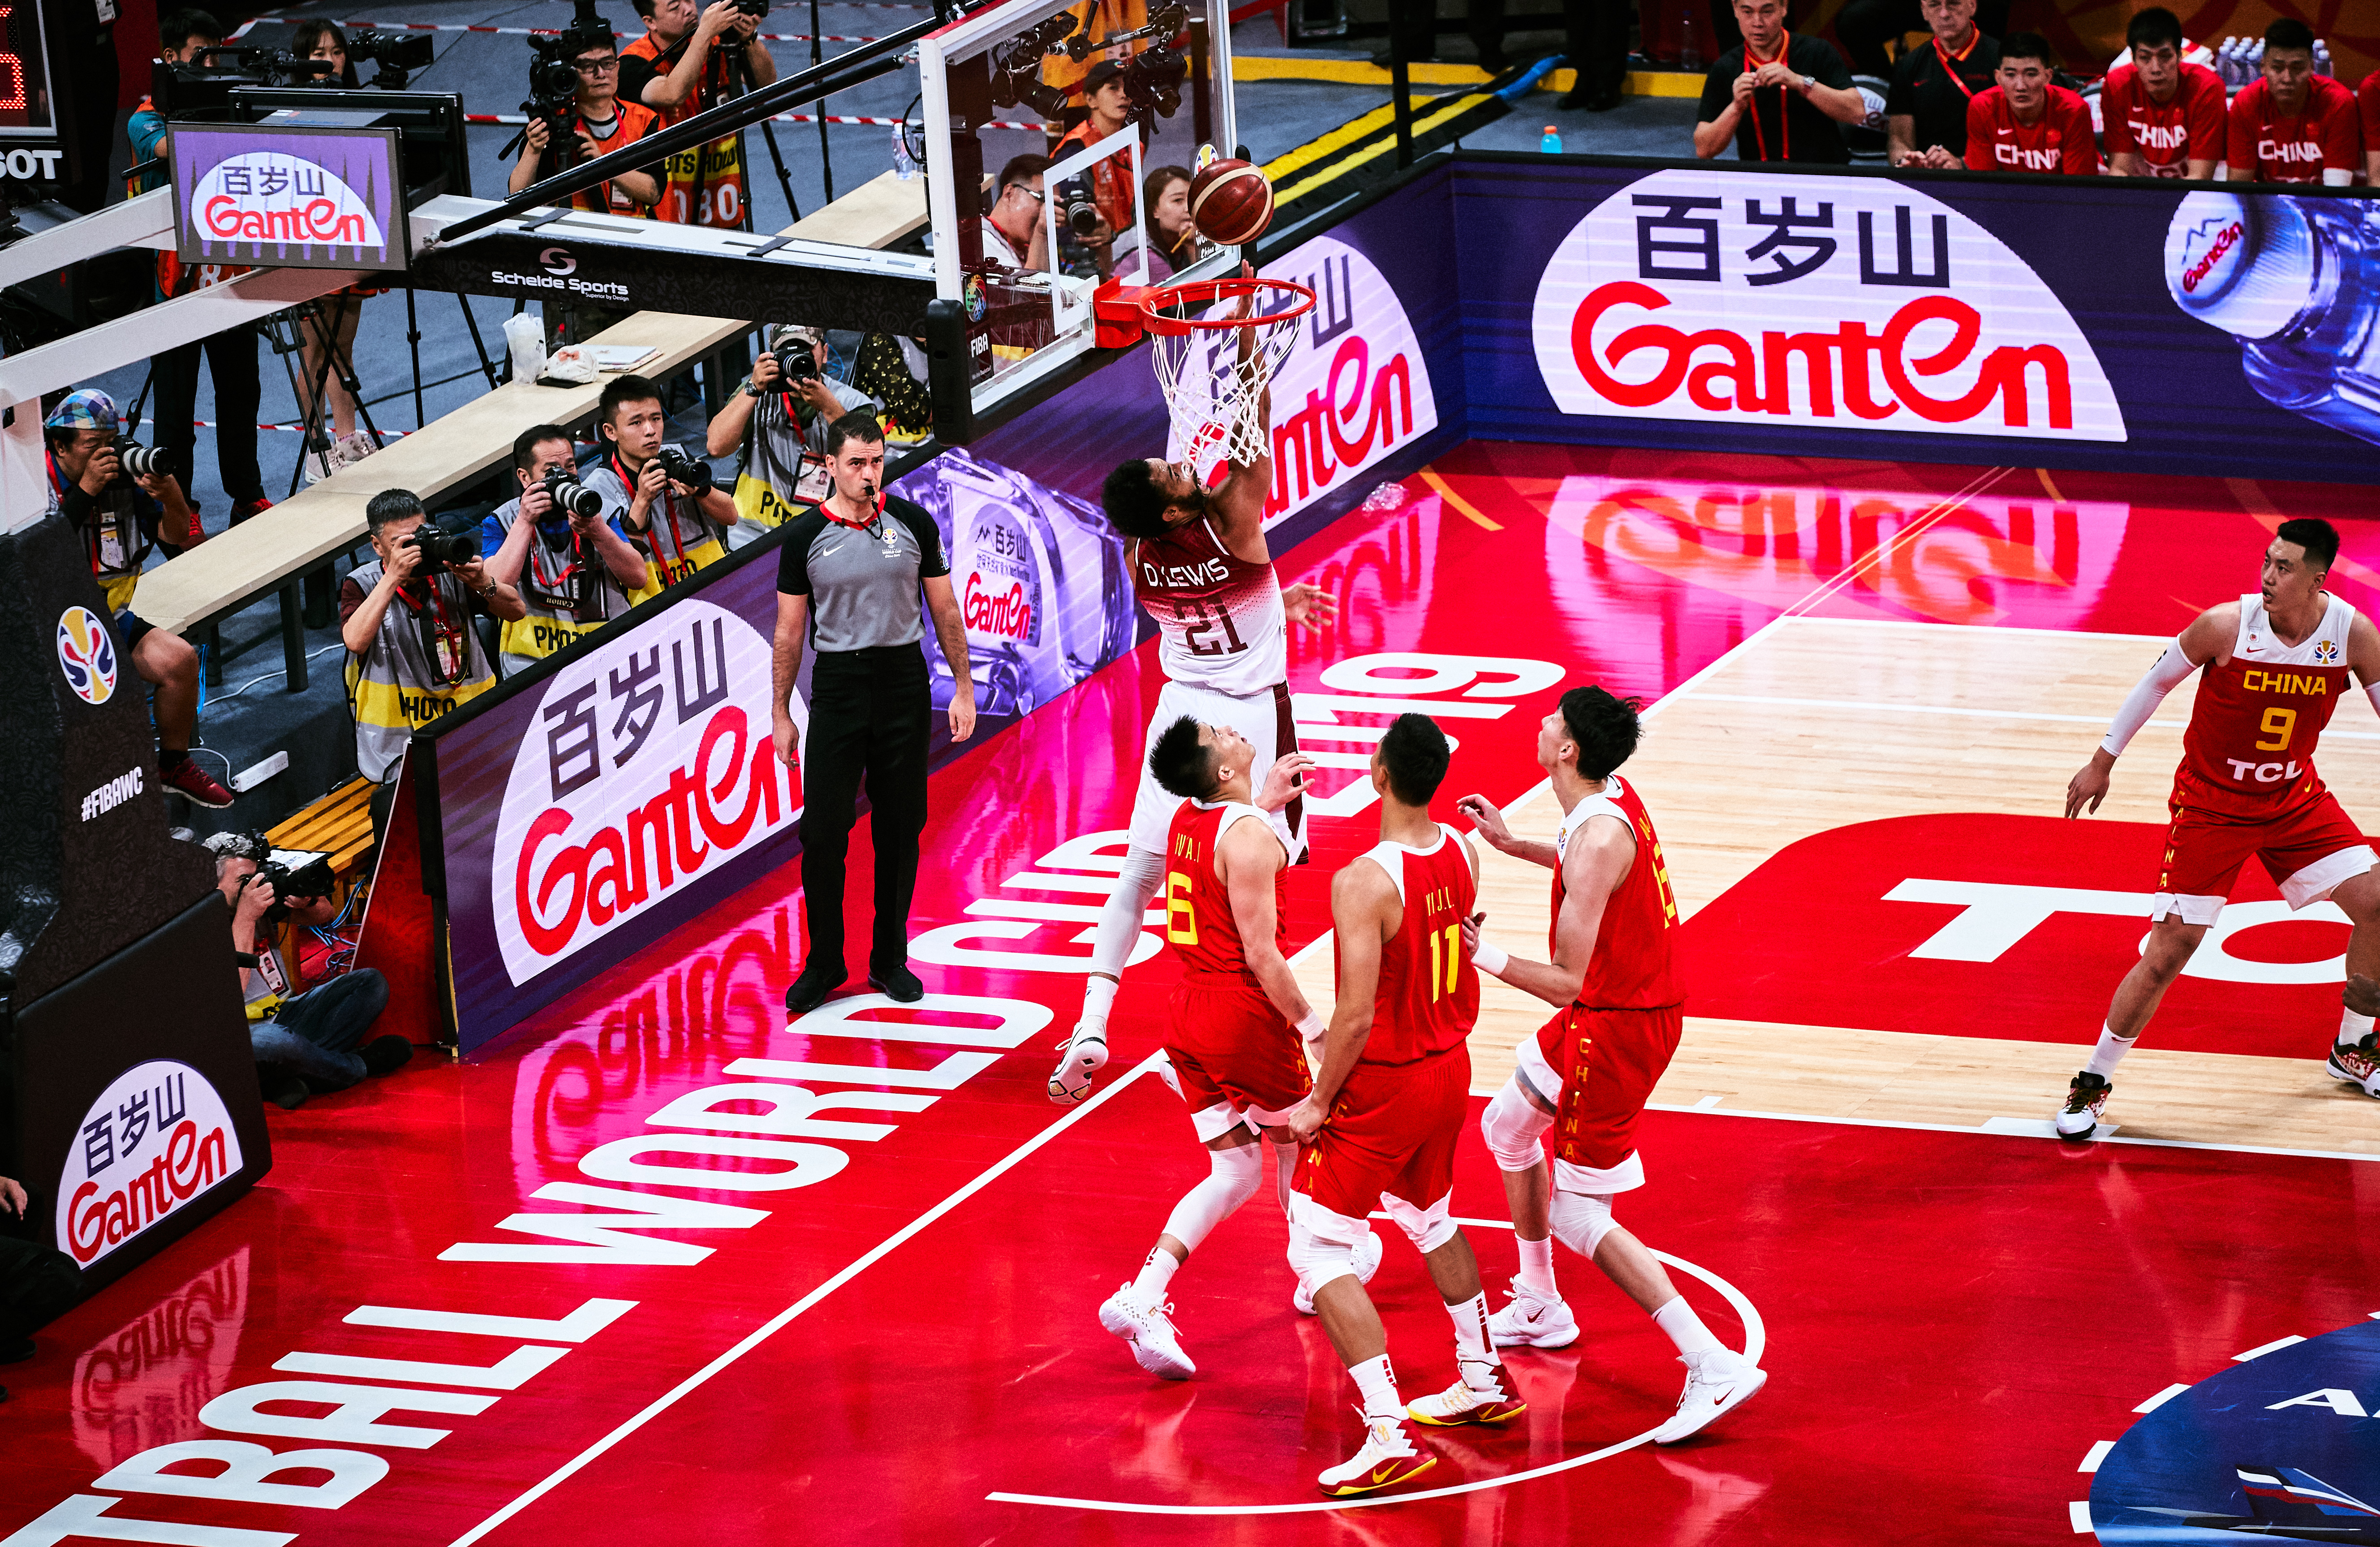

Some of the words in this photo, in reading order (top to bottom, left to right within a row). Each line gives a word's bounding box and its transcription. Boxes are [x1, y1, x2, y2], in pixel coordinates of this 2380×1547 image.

[222, 165, 324, 196] 百岁山
[2258, 140, 2324, 163] CHINA
[205, 195, 366, 242] Ganten
[1631, 194, 1950, 288] 百岁山
[492, 271, 565, 289] Schelde
[568, 279, 628, 295] Sports
[971, 333, 989, 358] FIBA
[1571, 280, 2073, 430] Ganten
[996, 524, 1026, 562] 百岁山
[547, 597, 574, 608] Canon
[964, 571, 1030, 640] Ganten
[1173, 595, 1248, 655] 21
[543, 618, 728, 802] 百岁山
[2243, 670, 2326, 695] CHINA
[2255, 707, 2297, 751] 9
[81, 766, 143, 822] #FIBAWC
[2227, 758, 2302, 783] TCL
[516, 705, 805, 956] Ganten
[1167, 871, 1198, 945] 6
[1431, 923, 1459, 1004] 11
[83, 1072, 186, 1178] 百岁山
[1565, 1038, 1591, 1159] CHINA
[437, 993, 1054, 1267] WORLD
[68, 1120, 227, 1262] Ganten
